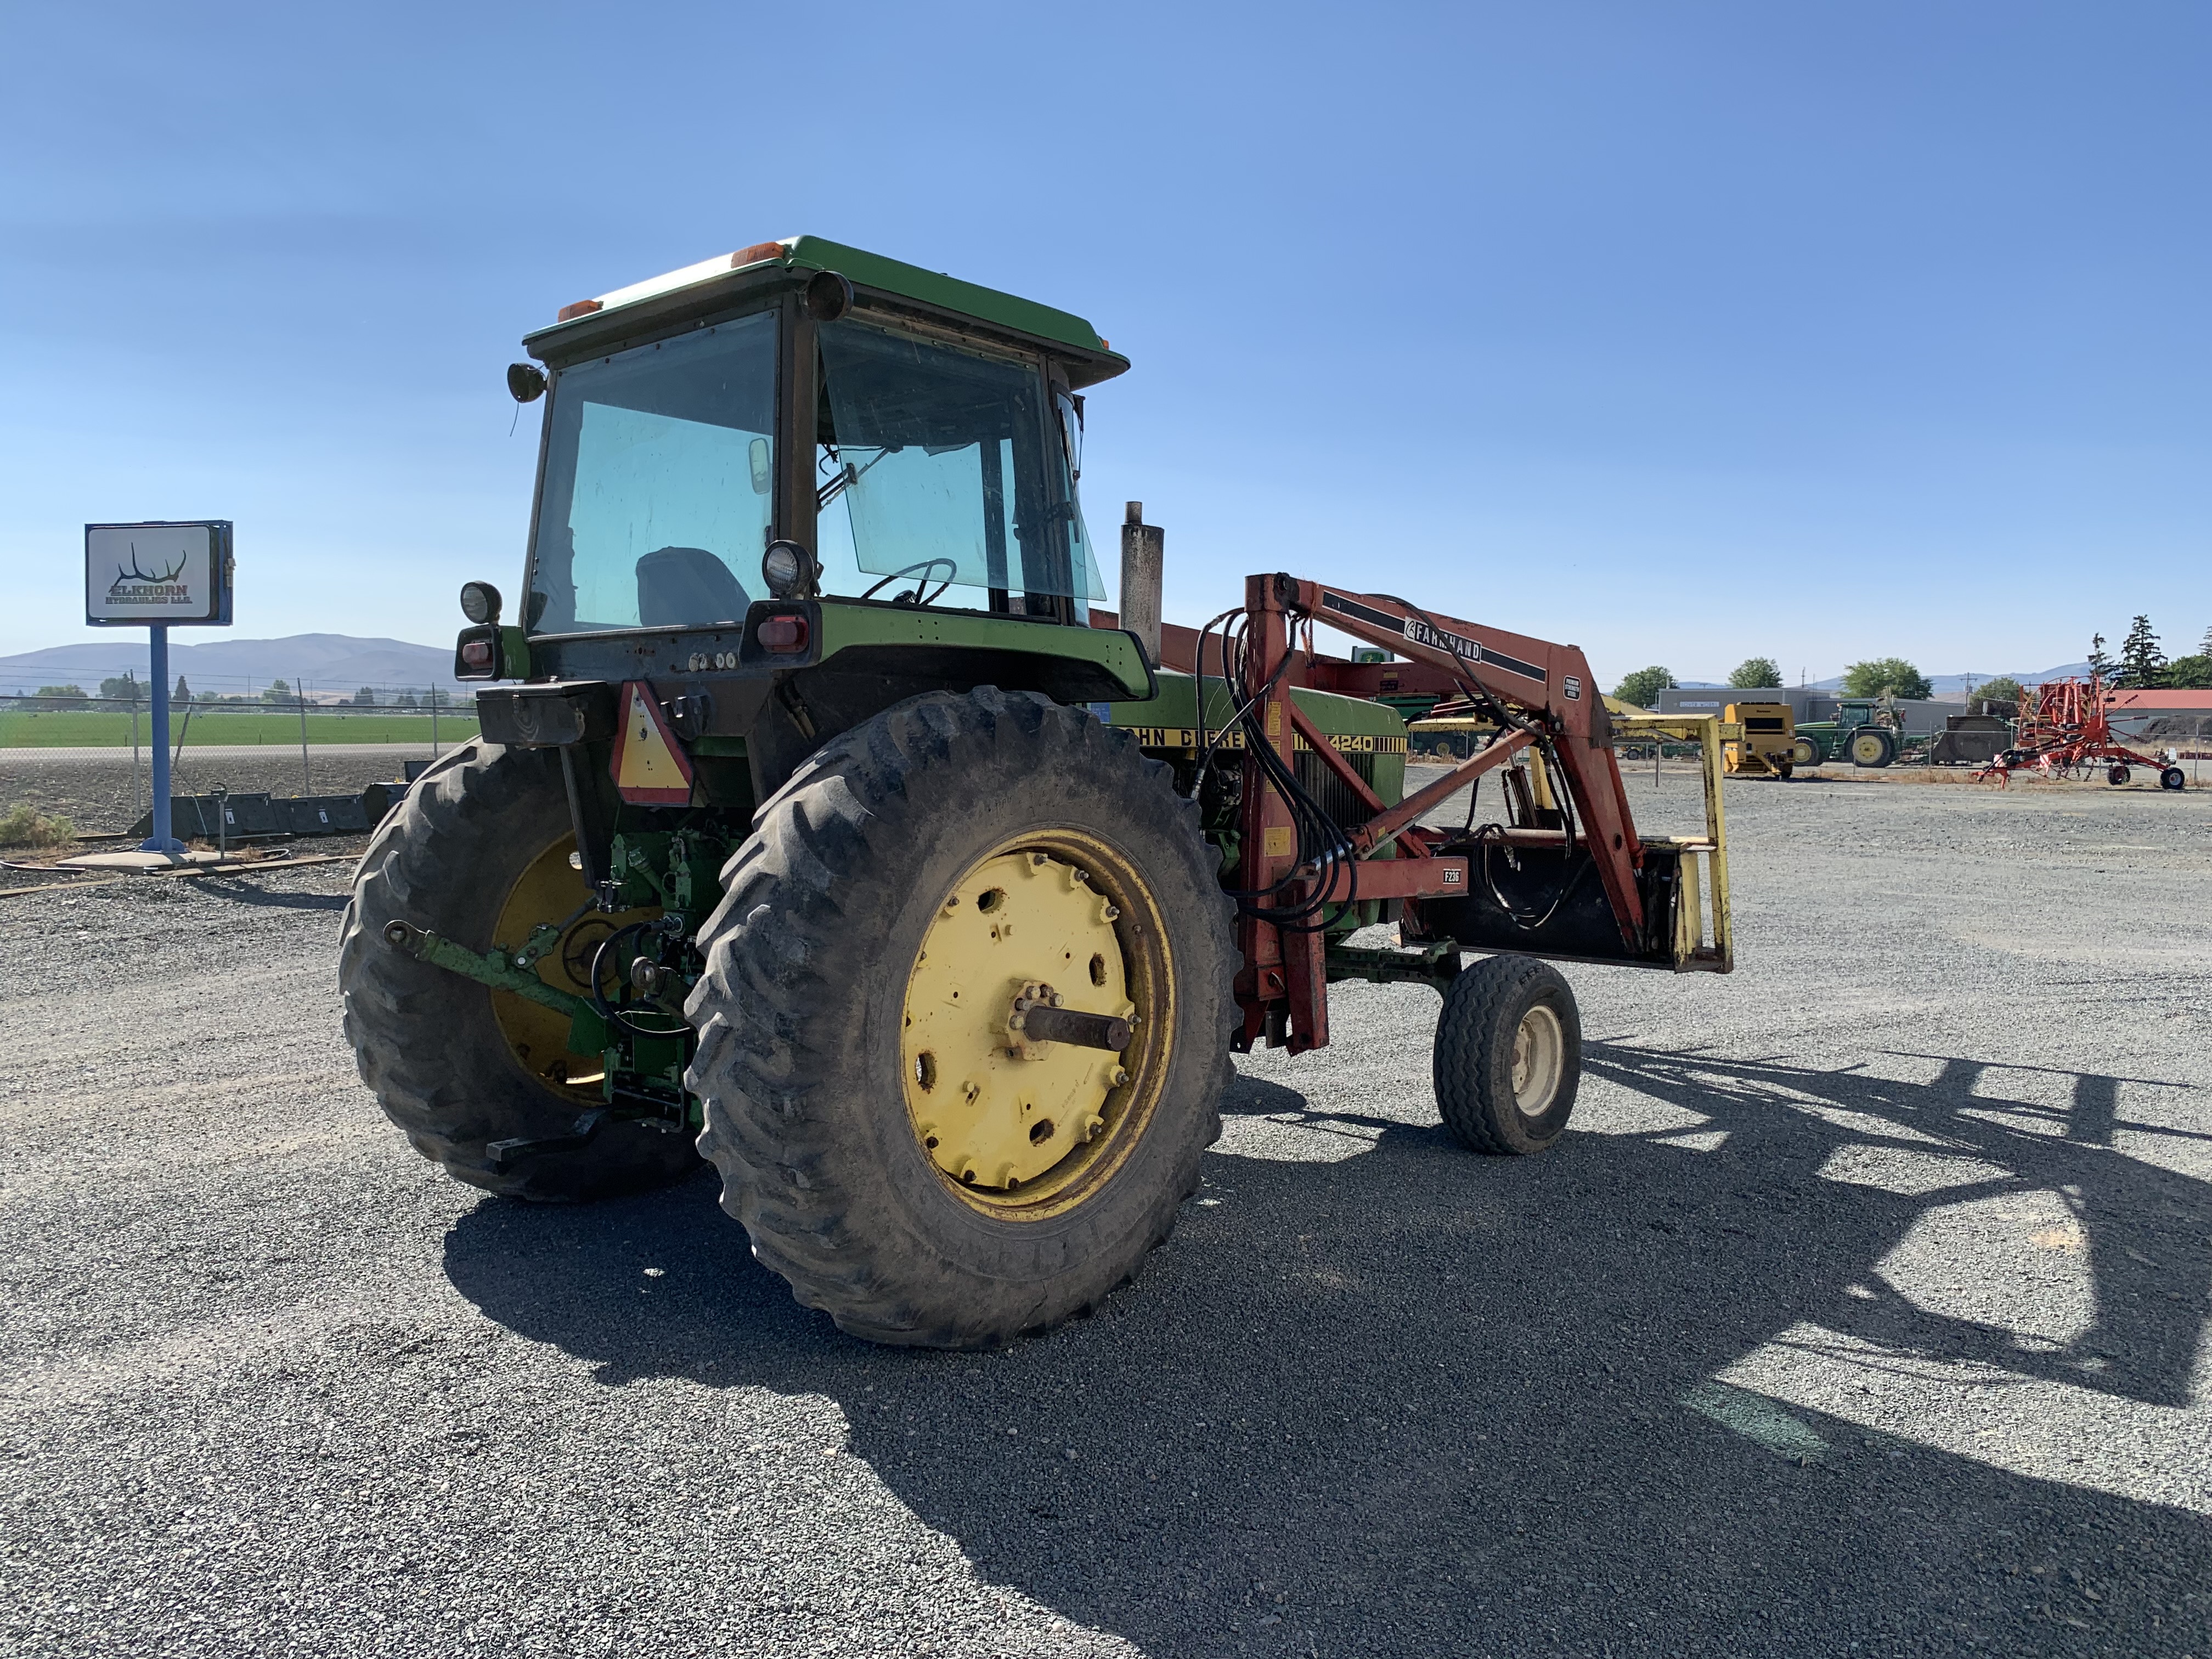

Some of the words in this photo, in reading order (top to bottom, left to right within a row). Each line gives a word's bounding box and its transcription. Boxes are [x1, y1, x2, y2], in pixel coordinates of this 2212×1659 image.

[110, 585, 188, 596] ELKHORN
[1565, 678, 1579, 686] PREMIUM
[1565, 684, 1579, 692] STRENGTH
[1329, 735, 1373, 752] 4240
[1444, 871, 1459, 882] F236
